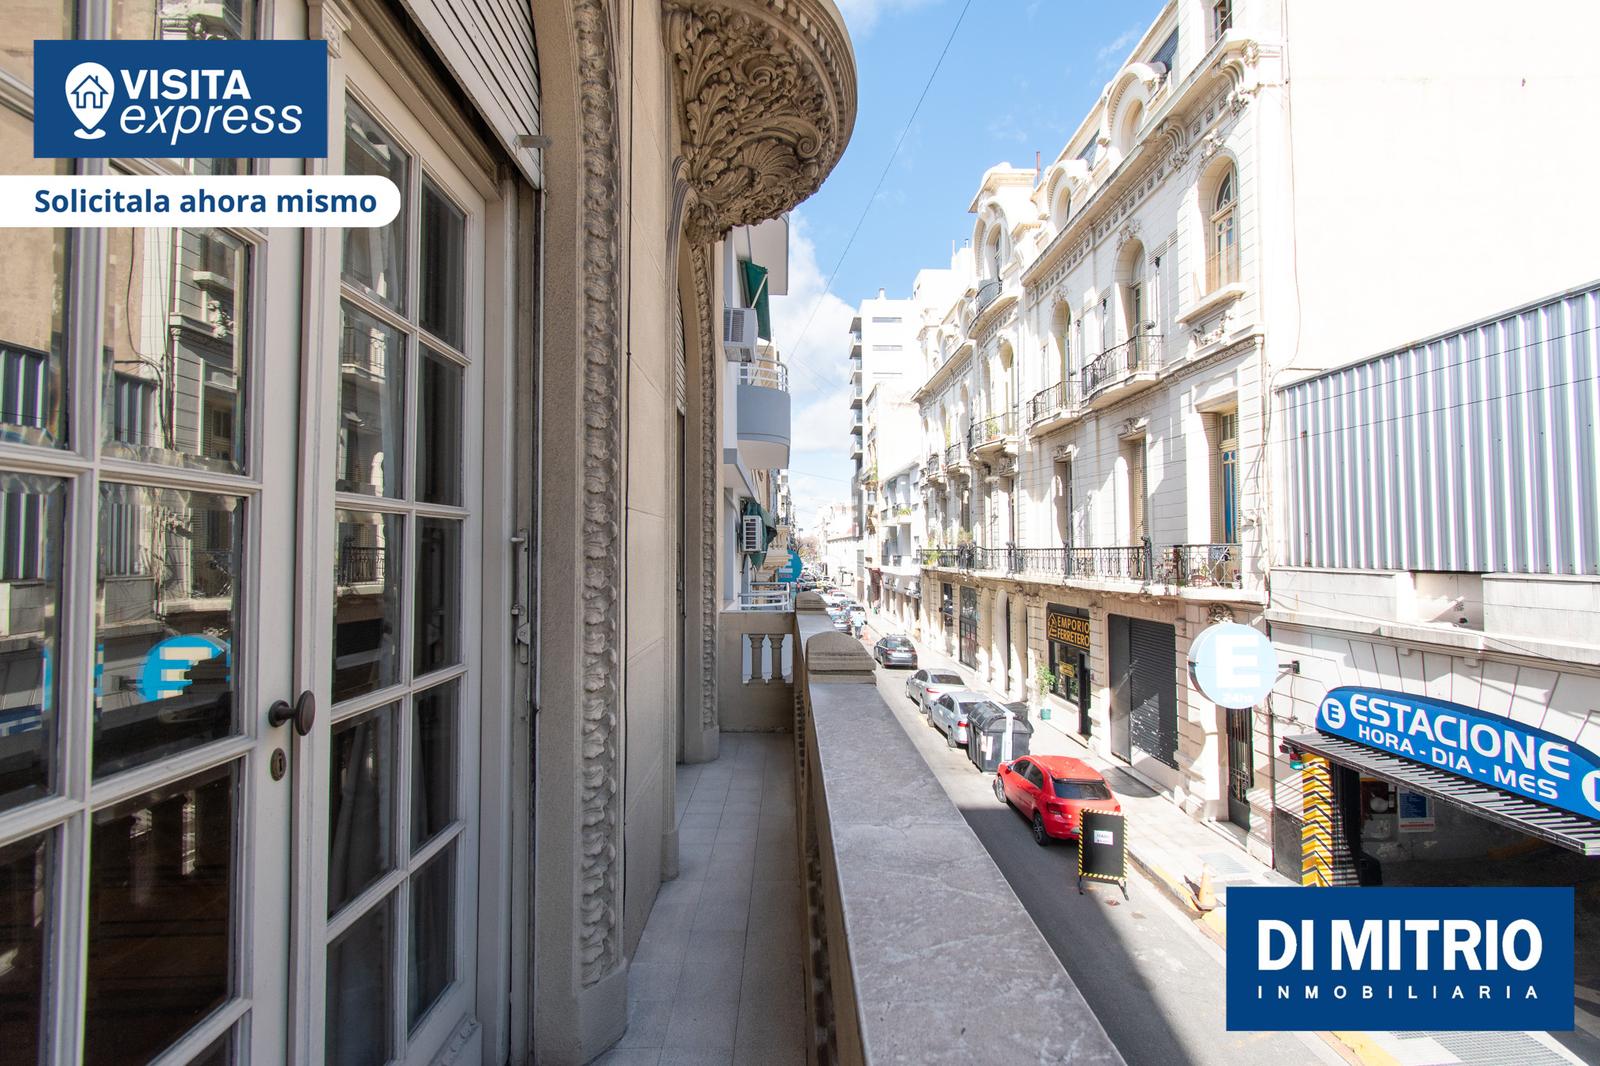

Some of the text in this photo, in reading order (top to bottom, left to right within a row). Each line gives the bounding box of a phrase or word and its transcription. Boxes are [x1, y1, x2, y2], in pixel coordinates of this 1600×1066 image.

[1057, 616, 1090, 634] EMPORIO
[1057, 627, 1090, 647] FERRETERO
[1215, 634, 1261, 688] E
[1349, 693, 1570, 781] ESTACIONE
[1358, 723, 1416, 756] HORA
[1431, 746, 1474, 775] DIA
[1493, 764, 1559, 800] MES
